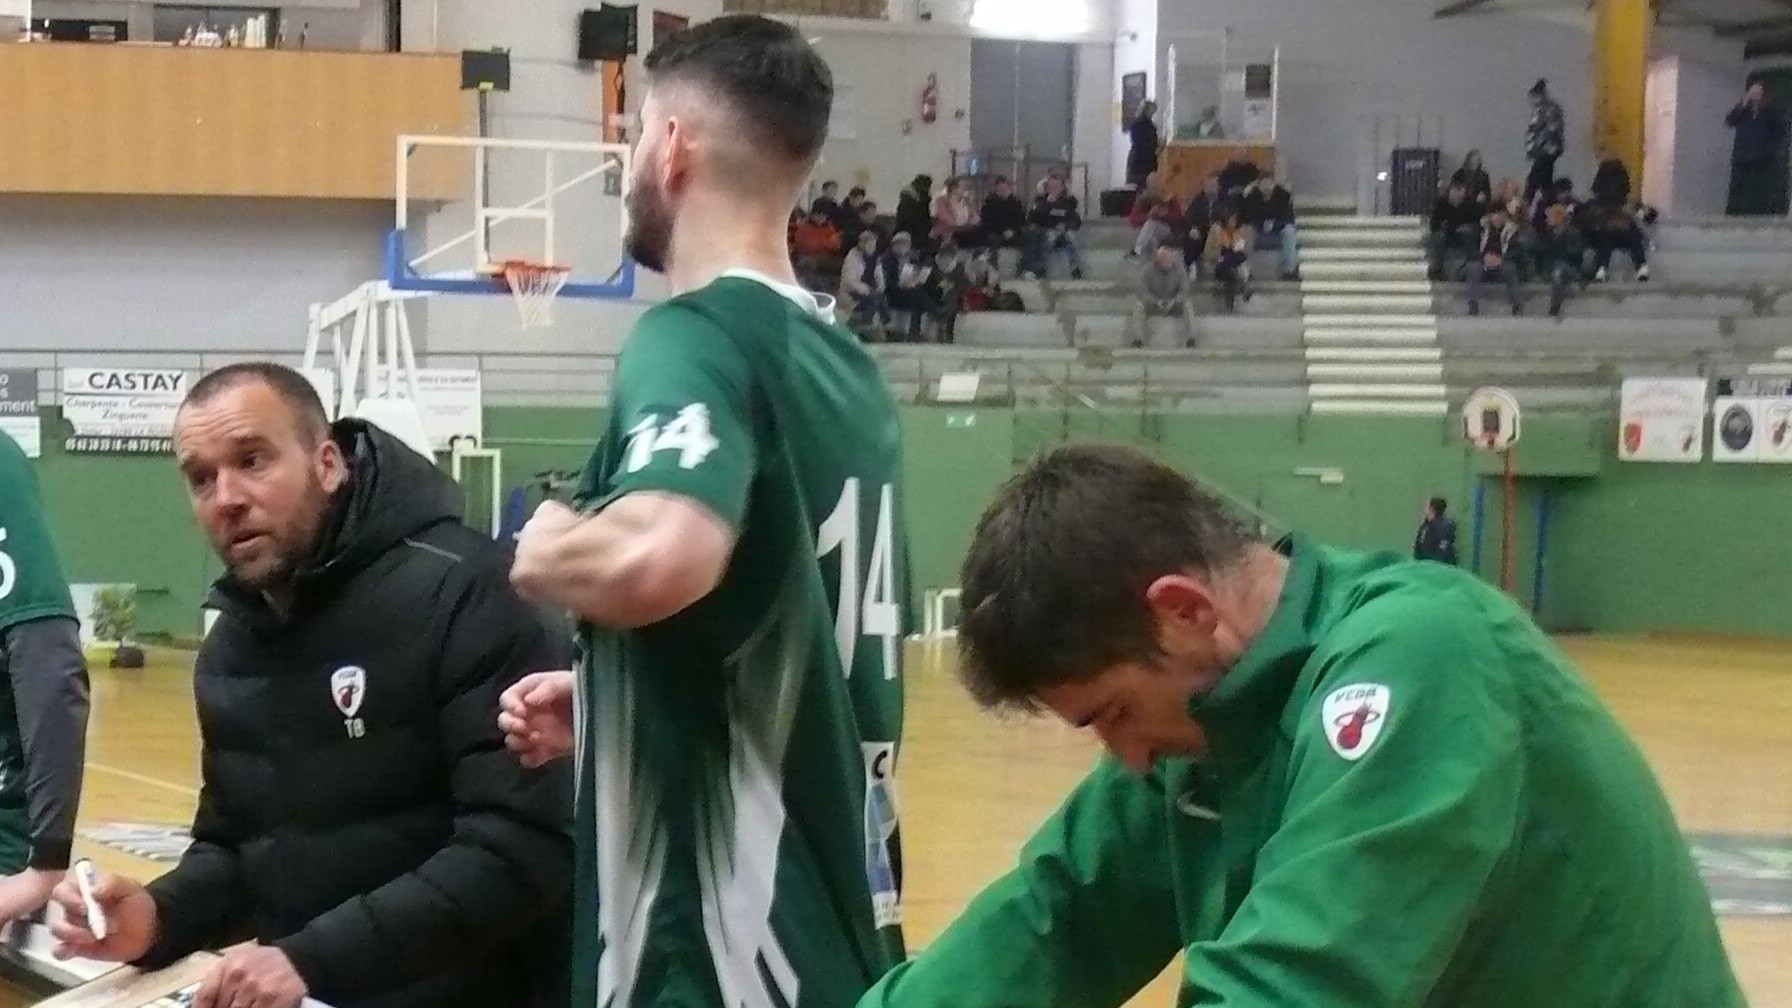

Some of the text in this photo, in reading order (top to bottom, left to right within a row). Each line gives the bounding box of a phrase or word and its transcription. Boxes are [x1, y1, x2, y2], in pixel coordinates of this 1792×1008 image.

[88, 372, 183, 391] CASTAY
[624, 402, 720, 475] 14
[817, 476, 901, 681] 14
